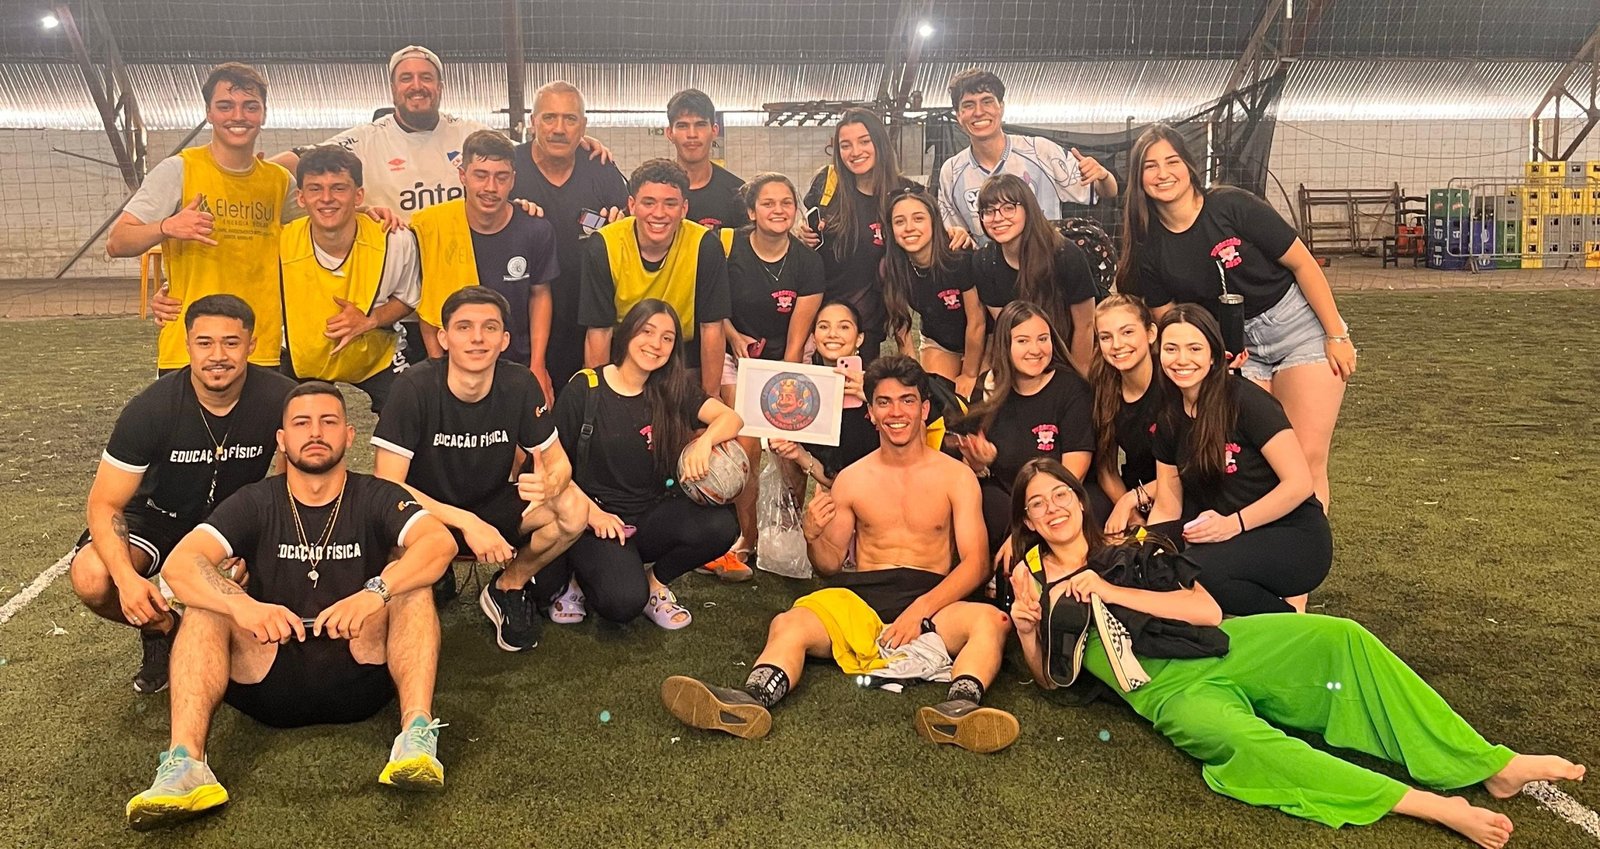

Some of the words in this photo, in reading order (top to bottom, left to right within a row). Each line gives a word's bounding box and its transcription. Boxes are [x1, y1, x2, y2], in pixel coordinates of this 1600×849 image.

[216, 198, 275, 222] EletriSul
[480, 430, 509, 448] FÍSICA
[228, 444, 263, 459] FÍSICA
[326, 541, 361, 560] FÍSICA
